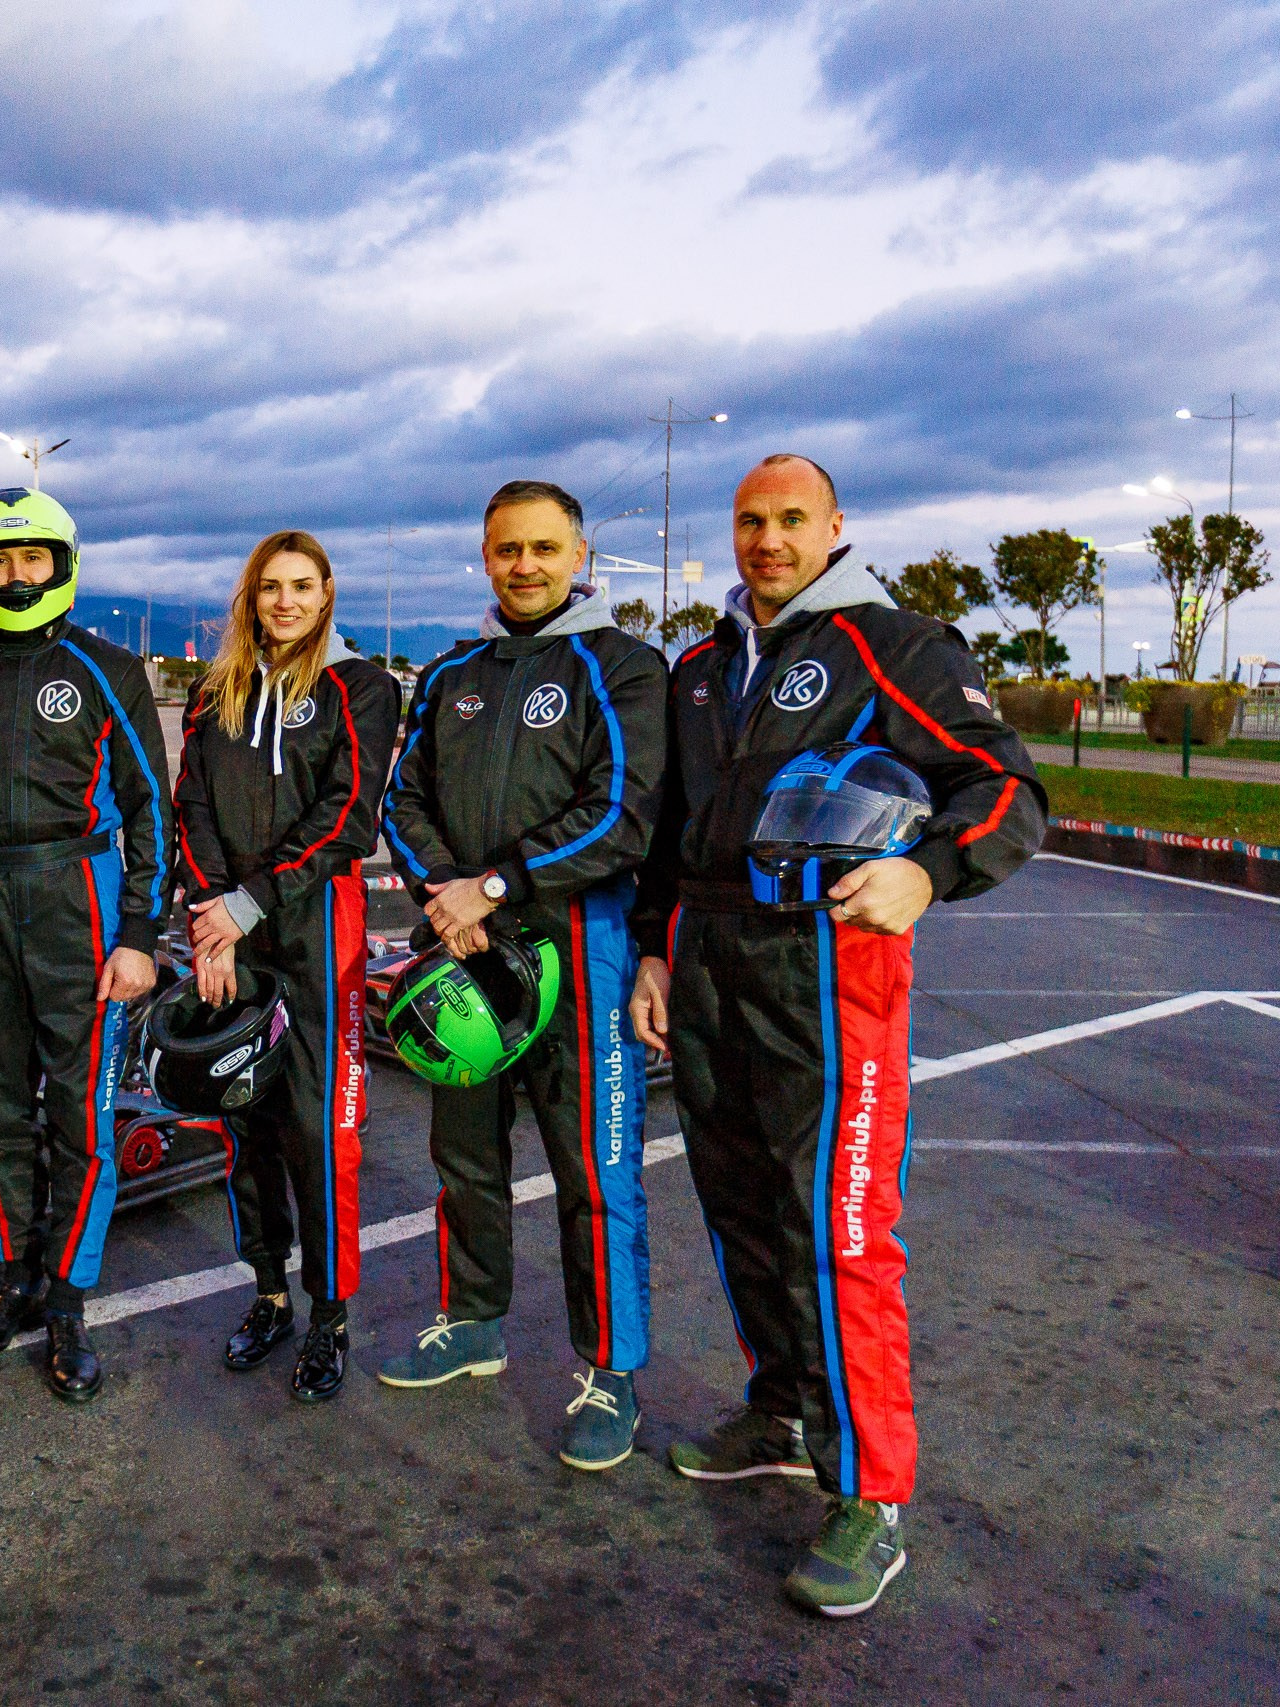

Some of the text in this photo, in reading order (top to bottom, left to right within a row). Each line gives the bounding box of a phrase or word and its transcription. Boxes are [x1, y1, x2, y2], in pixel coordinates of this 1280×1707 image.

[456, 702, 484, 711] RLG
[441, 983, 468, 1015] GSB
[218, 1050, 247, 1072] GSB
[340, 990, 362, 1128] kartingclub.pro
[604, 1008, 626, 1165] kartingclub.pro
[841, 1059, 878, 1257] kartingclub.pro
